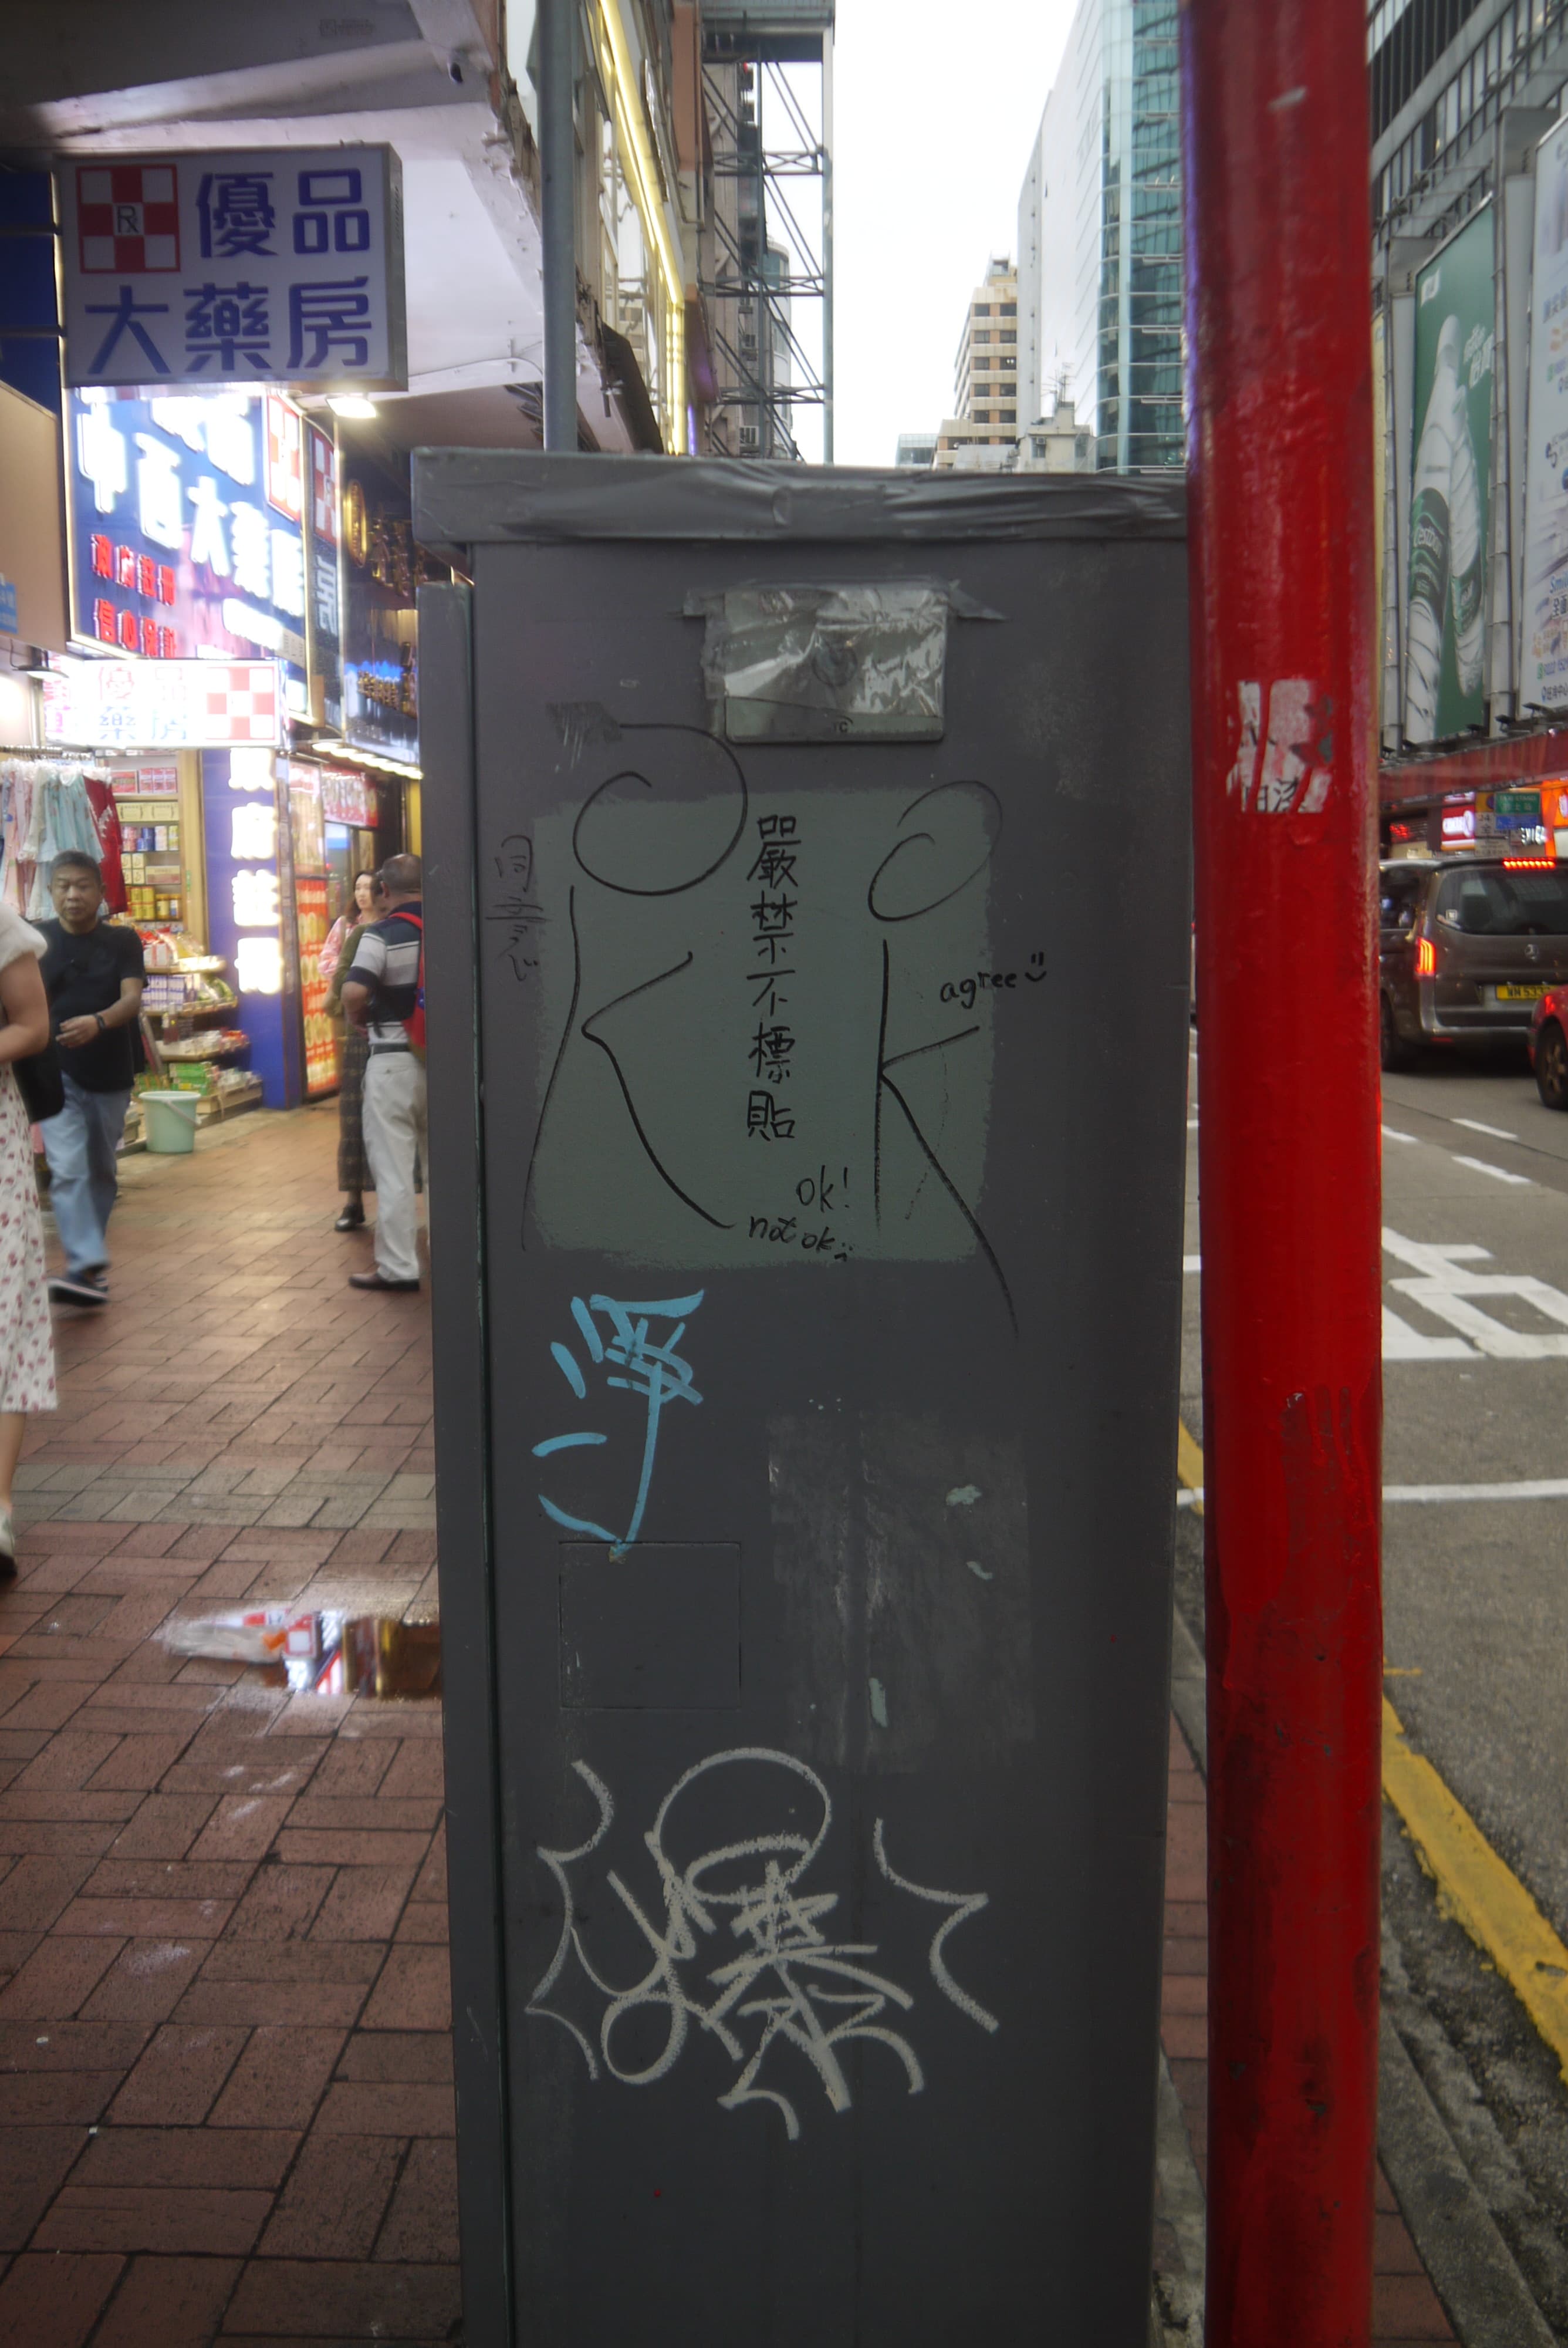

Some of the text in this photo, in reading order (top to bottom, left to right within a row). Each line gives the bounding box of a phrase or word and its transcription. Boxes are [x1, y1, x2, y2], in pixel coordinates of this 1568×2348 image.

[196, 168, 371, 258] 優品
[85, 275, 372, 375] 大藥房
[940, 971, 1017, 1010] agree
[749, 1216, 797, 1243] not
